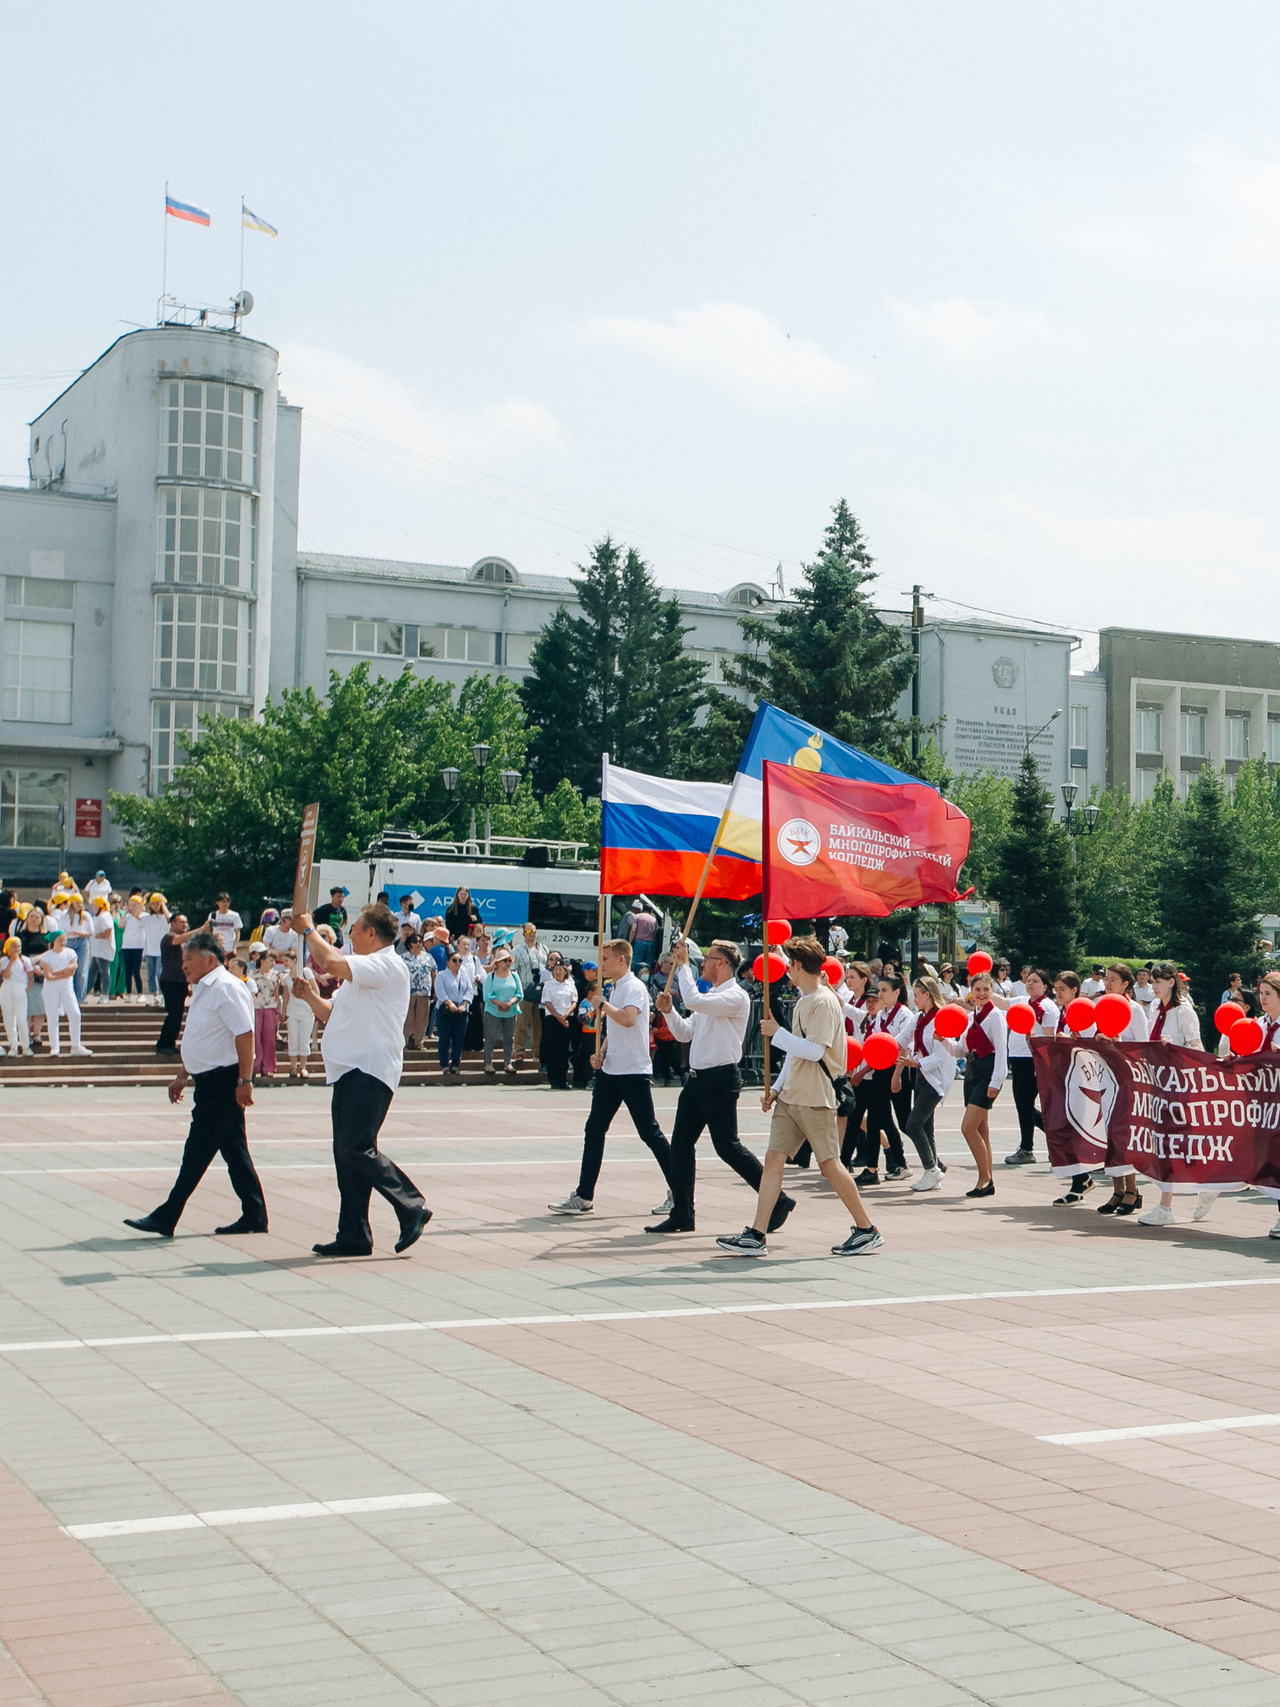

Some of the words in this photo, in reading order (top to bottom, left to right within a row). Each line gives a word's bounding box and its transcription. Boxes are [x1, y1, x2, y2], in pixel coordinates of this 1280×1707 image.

[994, 706, 1017, 715] УКАЗ
[829, 823, 911, 849] БАЙКАЛЬСКИЙ
[828, 852, 886, 871] КОЛЛЕДЖ
[432, 896, 496, 909] АРУС
[552, 934, 590, 943] 220-777
